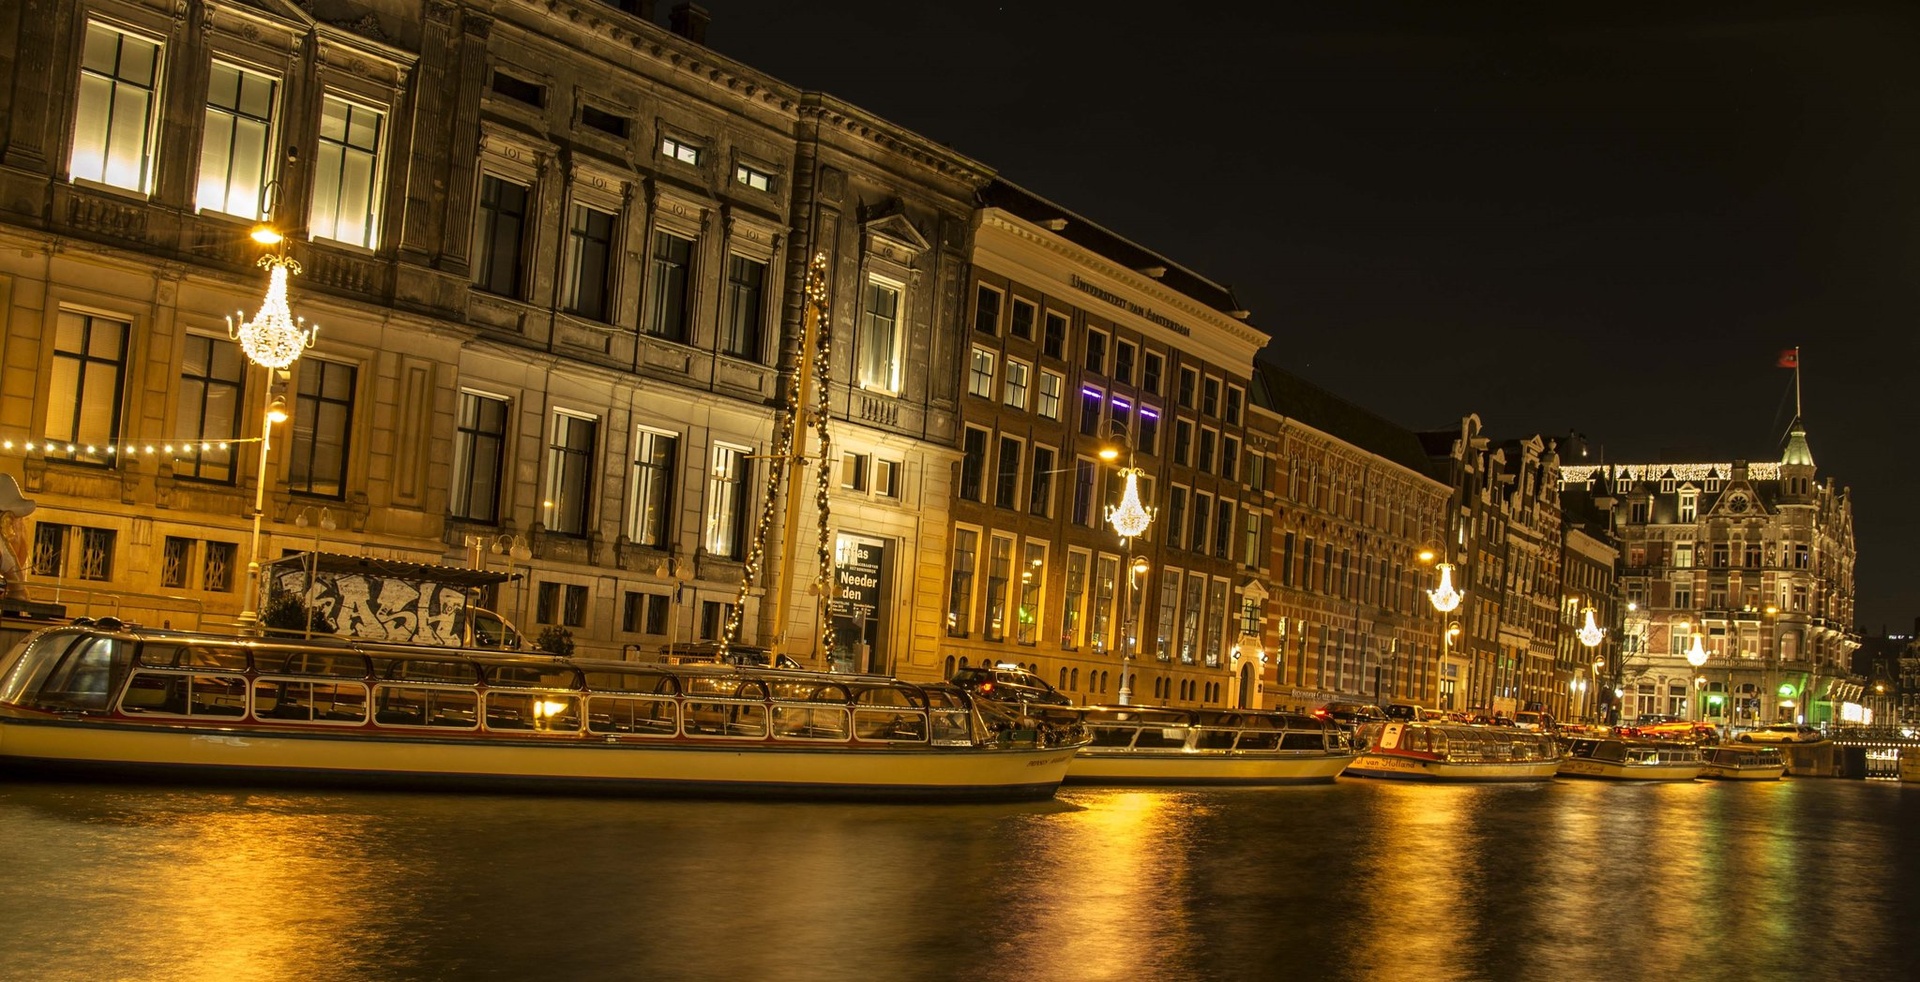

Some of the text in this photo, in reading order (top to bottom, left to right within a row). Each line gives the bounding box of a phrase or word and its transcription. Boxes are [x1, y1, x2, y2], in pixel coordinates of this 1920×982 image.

[840, 571, 878, 588] Needer
[842, 586, 861, 600] den
[1381, 758, 1416, 769] Holland
